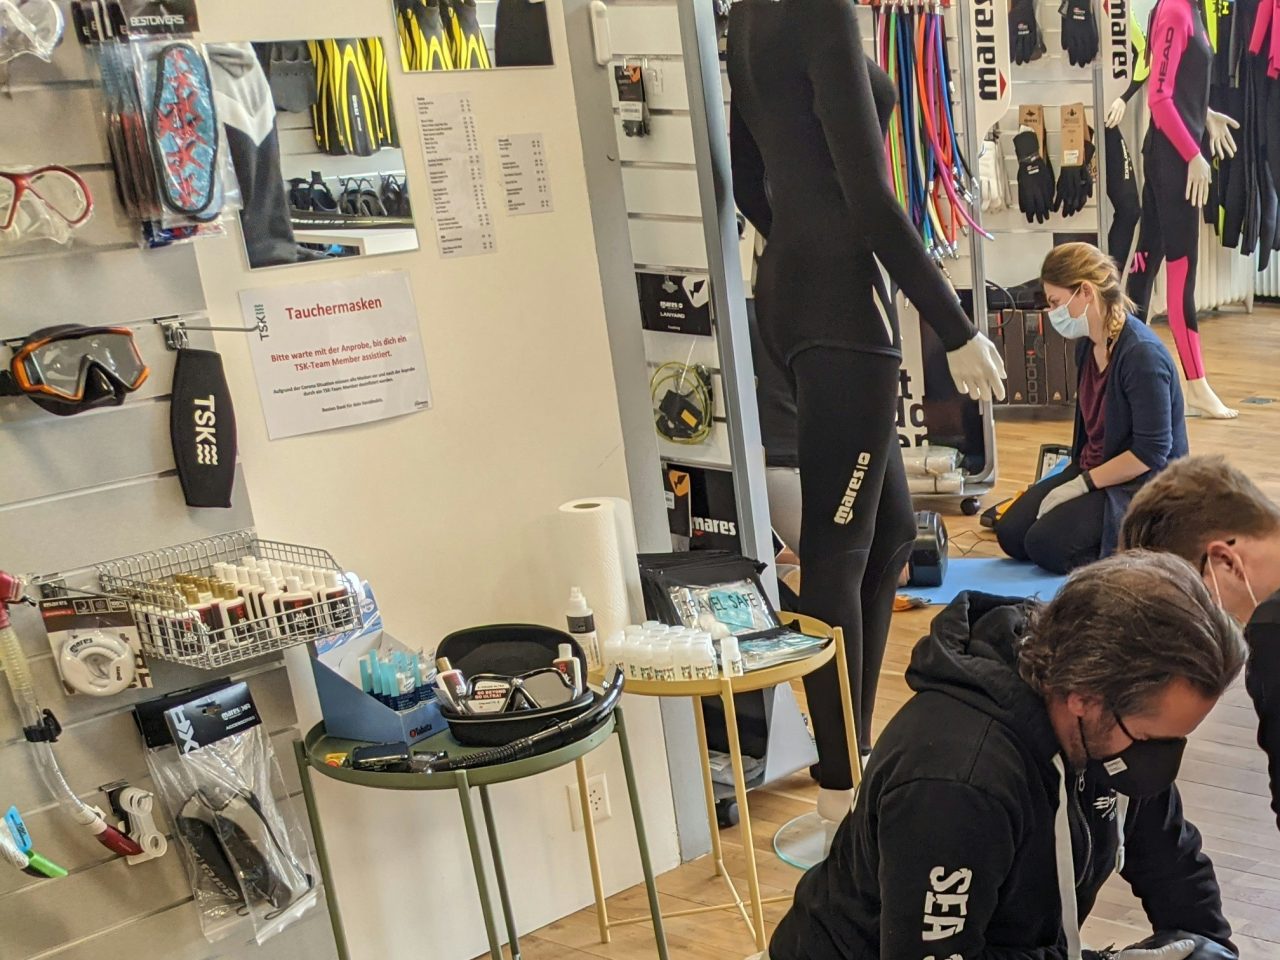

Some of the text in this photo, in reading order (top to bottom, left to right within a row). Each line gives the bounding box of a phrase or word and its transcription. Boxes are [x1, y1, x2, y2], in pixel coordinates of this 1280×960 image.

[1110, 0, 1128, 80] mares
[1156, 26, 1174, 94] HEAD
[285, 296, 382, 320] Tauchermasken
[256, 315, 270, 342] TSK
[270, 335, 407, 363] Bitte warte mit der Anprobe, bis dich ein
[294, 350, 392, 372] TSK-Team Member assistiert.
[194, 394, 216, 444] TSK
[834, 470, 865, 525] mares
[692, 515, 737, 536] mares
[728, 592, 760, 610] SAFE
[922, 866, 973, 941] SEA
